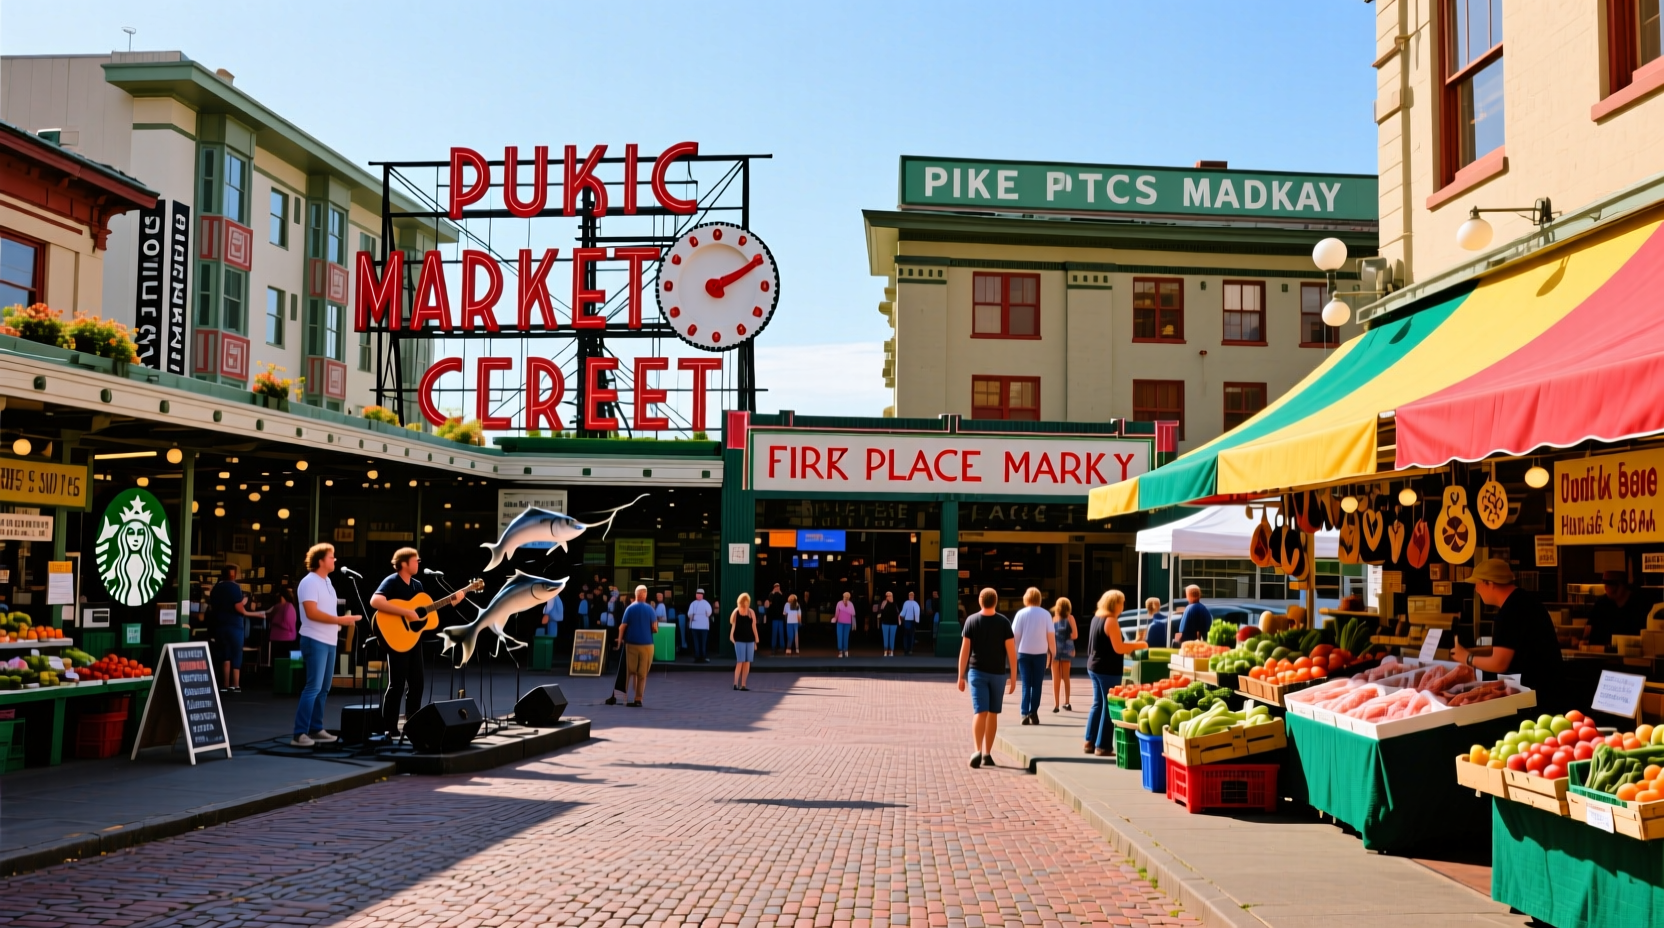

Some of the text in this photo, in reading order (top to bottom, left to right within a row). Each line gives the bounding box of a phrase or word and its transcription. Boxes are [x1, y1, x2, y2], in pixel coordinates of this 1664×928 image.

[449, 141, 699, 220] PUKIC
[924, 166, 1019, 200] PIKE
[1182, 177, 1342, 212] MADKAY
[354, 247, 661, 332] MARKET
[866, 448, 982, 483] PLACE
